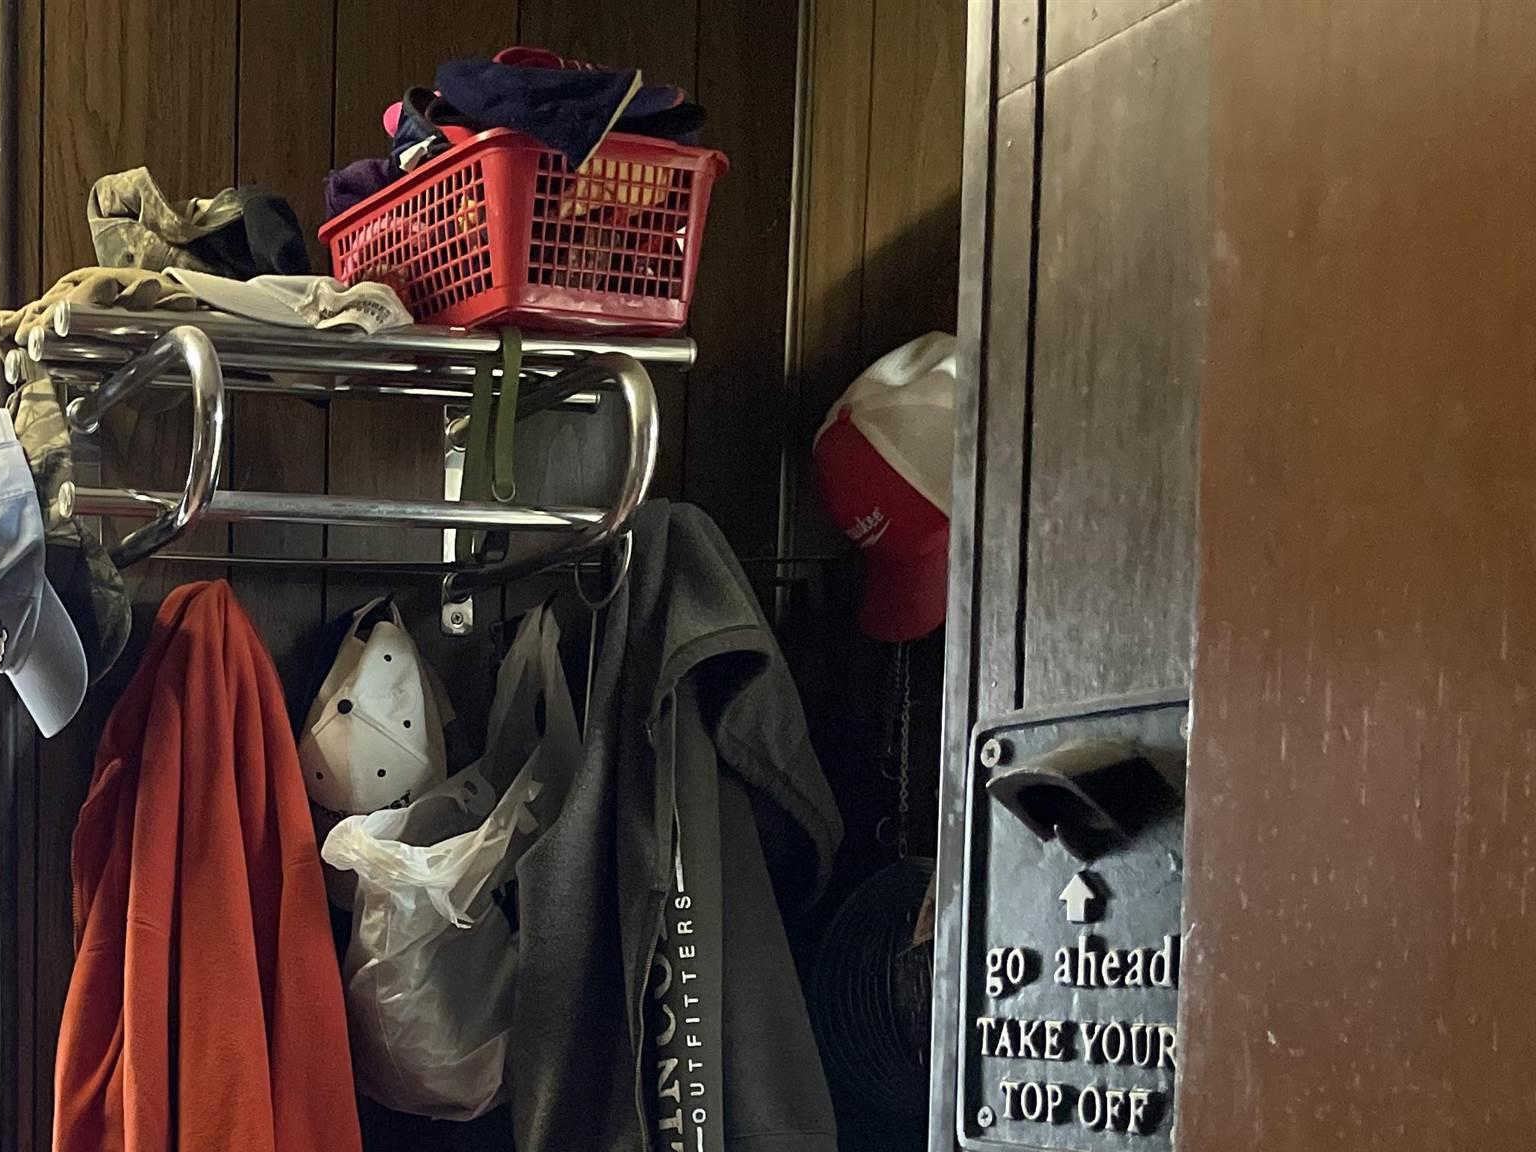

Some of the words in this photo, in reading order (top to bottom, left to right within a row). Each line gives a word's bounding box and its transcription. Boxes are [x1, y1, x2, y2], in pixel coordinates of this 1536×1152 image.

[985, 946, 1025, 998] go
[1053, 934, 1173, 988] ahead
[675, 895, 707, 1124] OUTFITTERS
[976, 1016, 1064, 1061] TAKE
[1078, 1022, 1177, 1068] YOUR
[998, 1080, 1063, 1121] TOP
[1077, 1084, 1152, 1134] OFF
